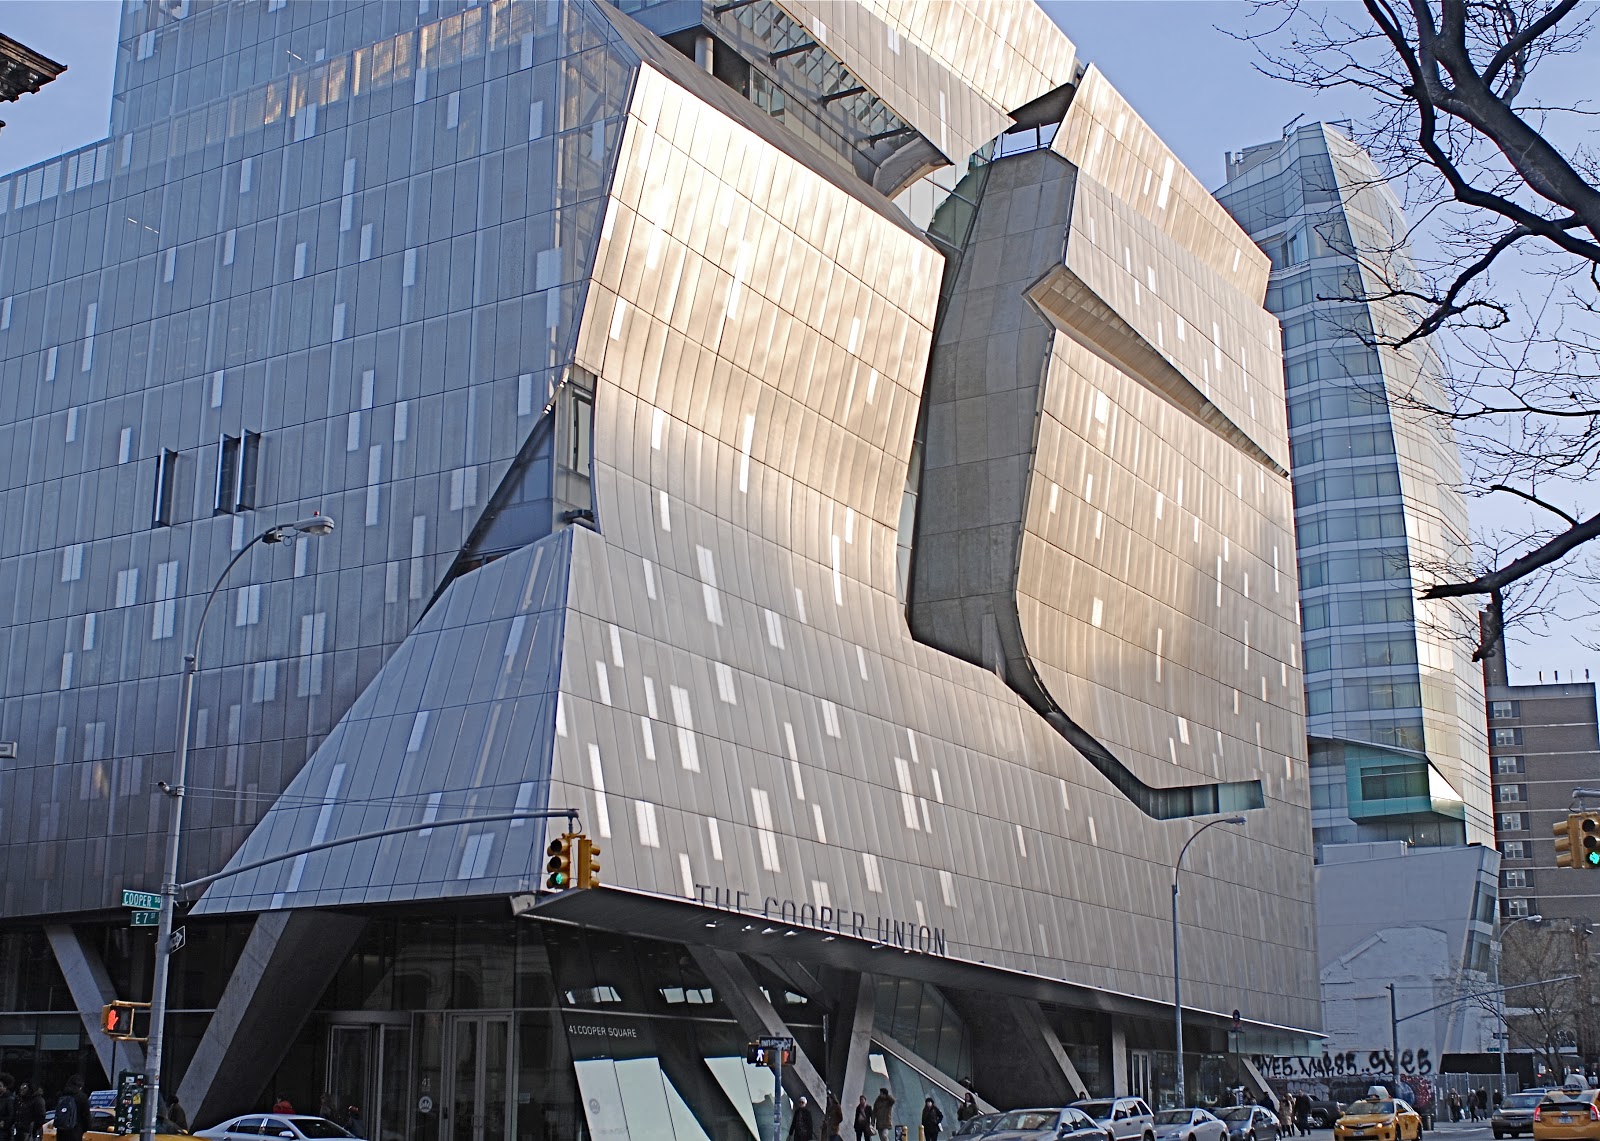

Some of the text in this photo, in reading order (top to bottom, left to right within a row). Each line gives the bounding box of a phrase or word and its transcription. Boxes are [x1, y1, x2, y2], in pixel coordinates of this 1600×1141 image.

[124, 892, 152, 906] COOPER
[136, 913, 140, 924] E
[144, 913, 148, 924] 7
[696, 884, 947, 958] THE COOPER UNION
[568, 1026, 636, 1038] 41 COOPER SQUARE
